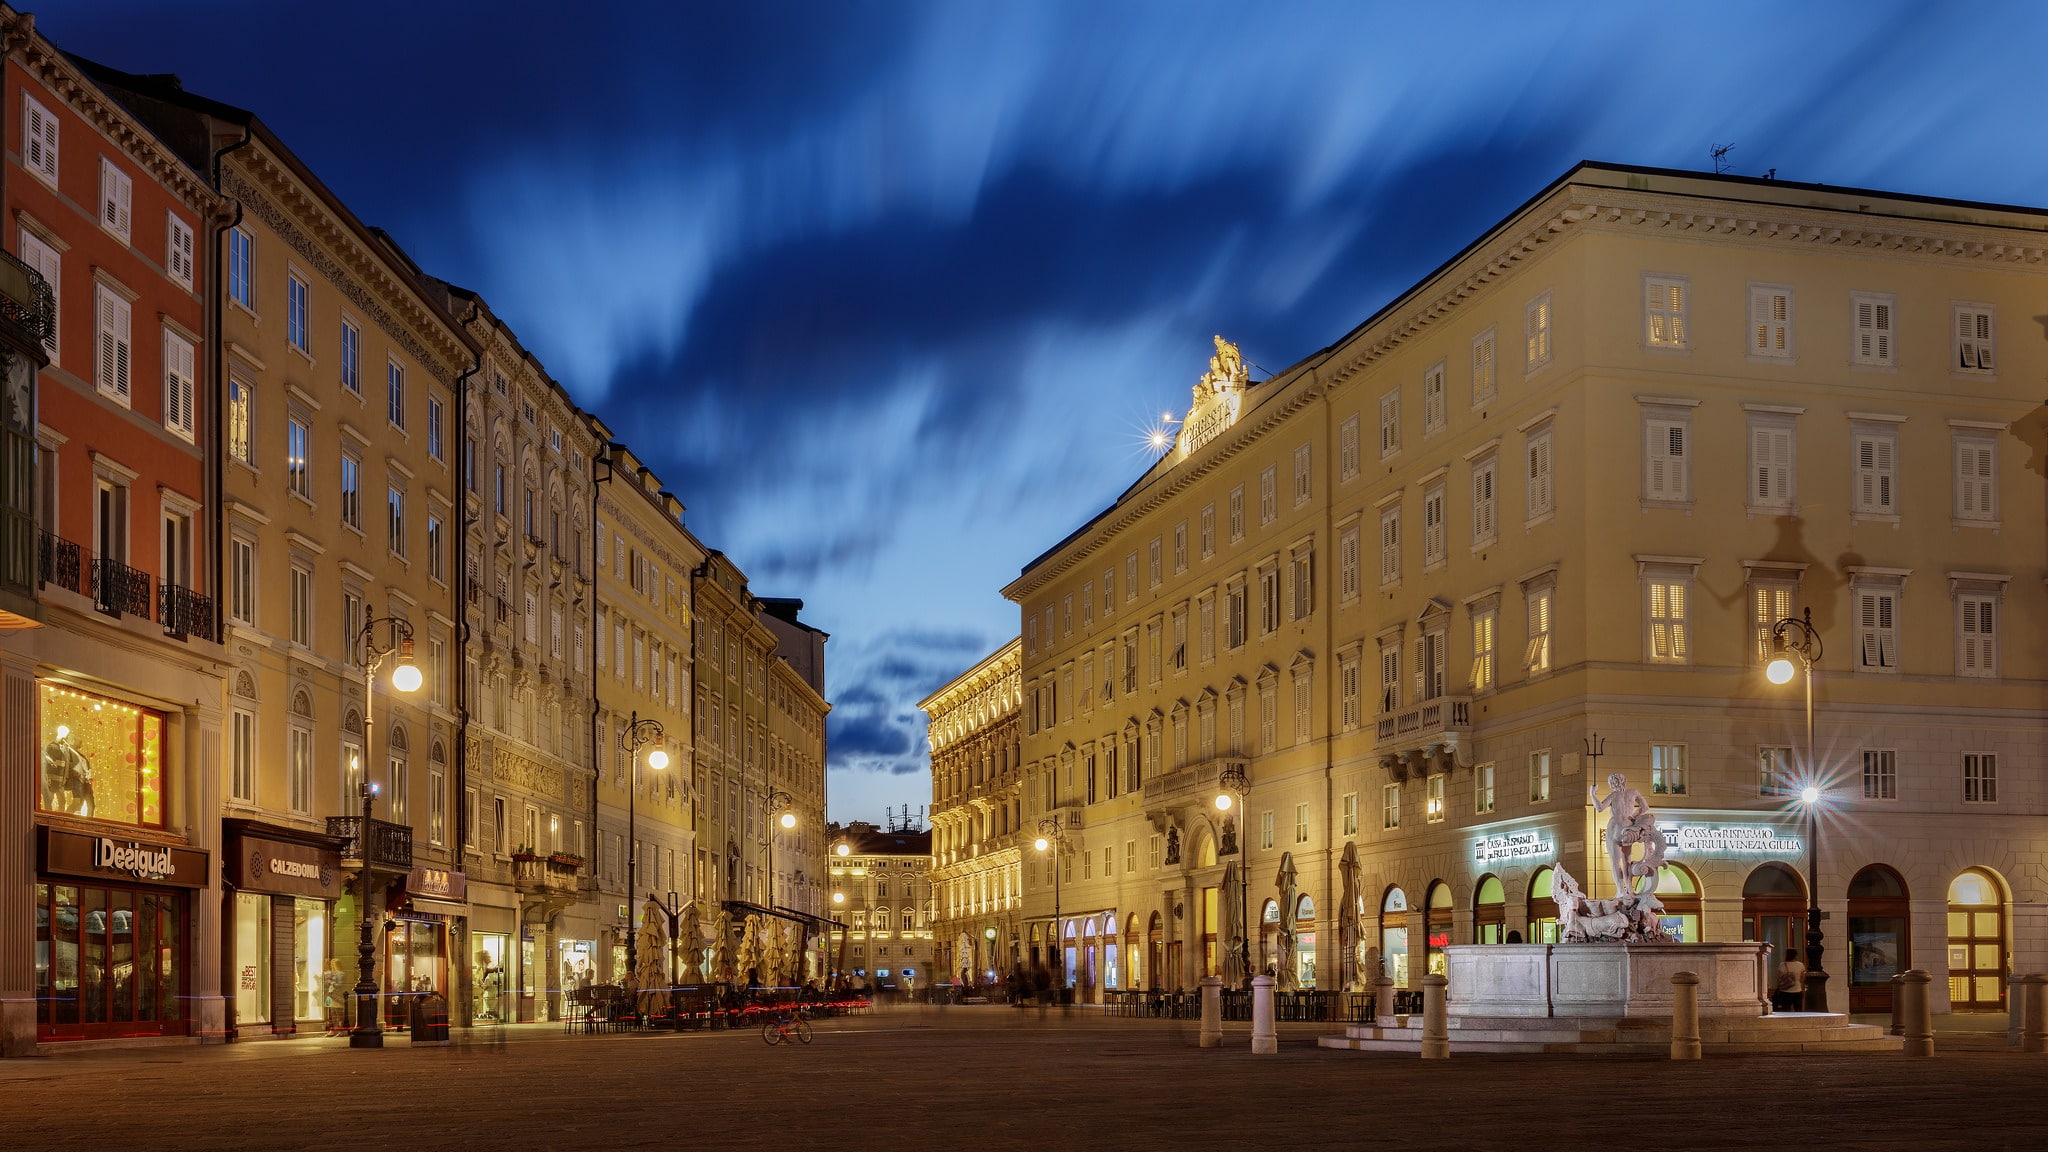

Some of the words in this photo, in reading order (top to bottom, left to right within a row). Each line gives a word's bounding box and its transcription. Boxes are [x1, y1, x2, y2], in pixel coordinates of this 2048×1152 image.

[1685, 828, 1712, 838] CASSA
[1722, 829, 1773, 839] RISPARMIO
[1697, 839, 1727, 849] FRIULI
[1729, 840, 1768, 850] VENEZIA
[1768, 840, 1801, 850] GIULIA
[99, 838, 172, 878] Desigual
[270, 858, 320, 880] CALZEDONIA
